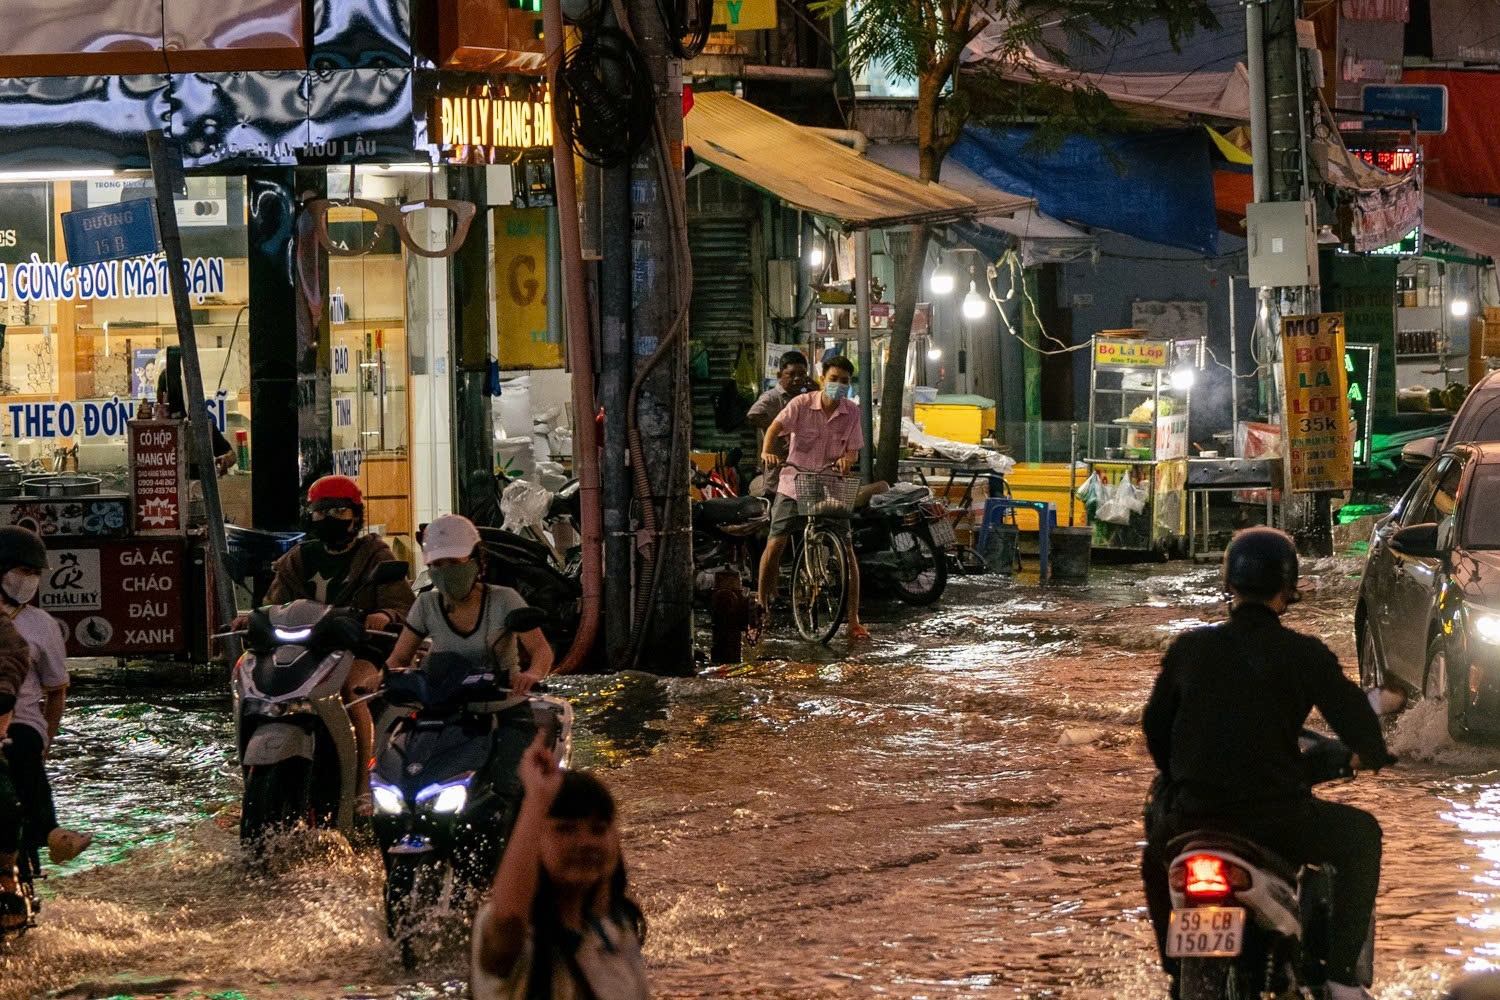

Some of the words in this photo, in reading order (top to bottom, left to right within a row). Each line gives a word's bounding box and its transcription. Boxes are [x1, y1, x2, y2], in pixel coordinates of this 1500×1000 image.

[14, 254, 74, 300] CÙNG
[1327, 317, 1340, 335] 2
[9, 403, 76, 438] THEO
[137, 453, 163, 466] MANG
[120, 547, 146, 566] GÀ
[150, 546, 174, 565] ÁC
[122, 573, 173, 592] CHÁO
[129, 599, 168, 621] ĐẬU
[124, 628, 175, 644] XANH
[1181, 911, 1232, 931] 59-CB
